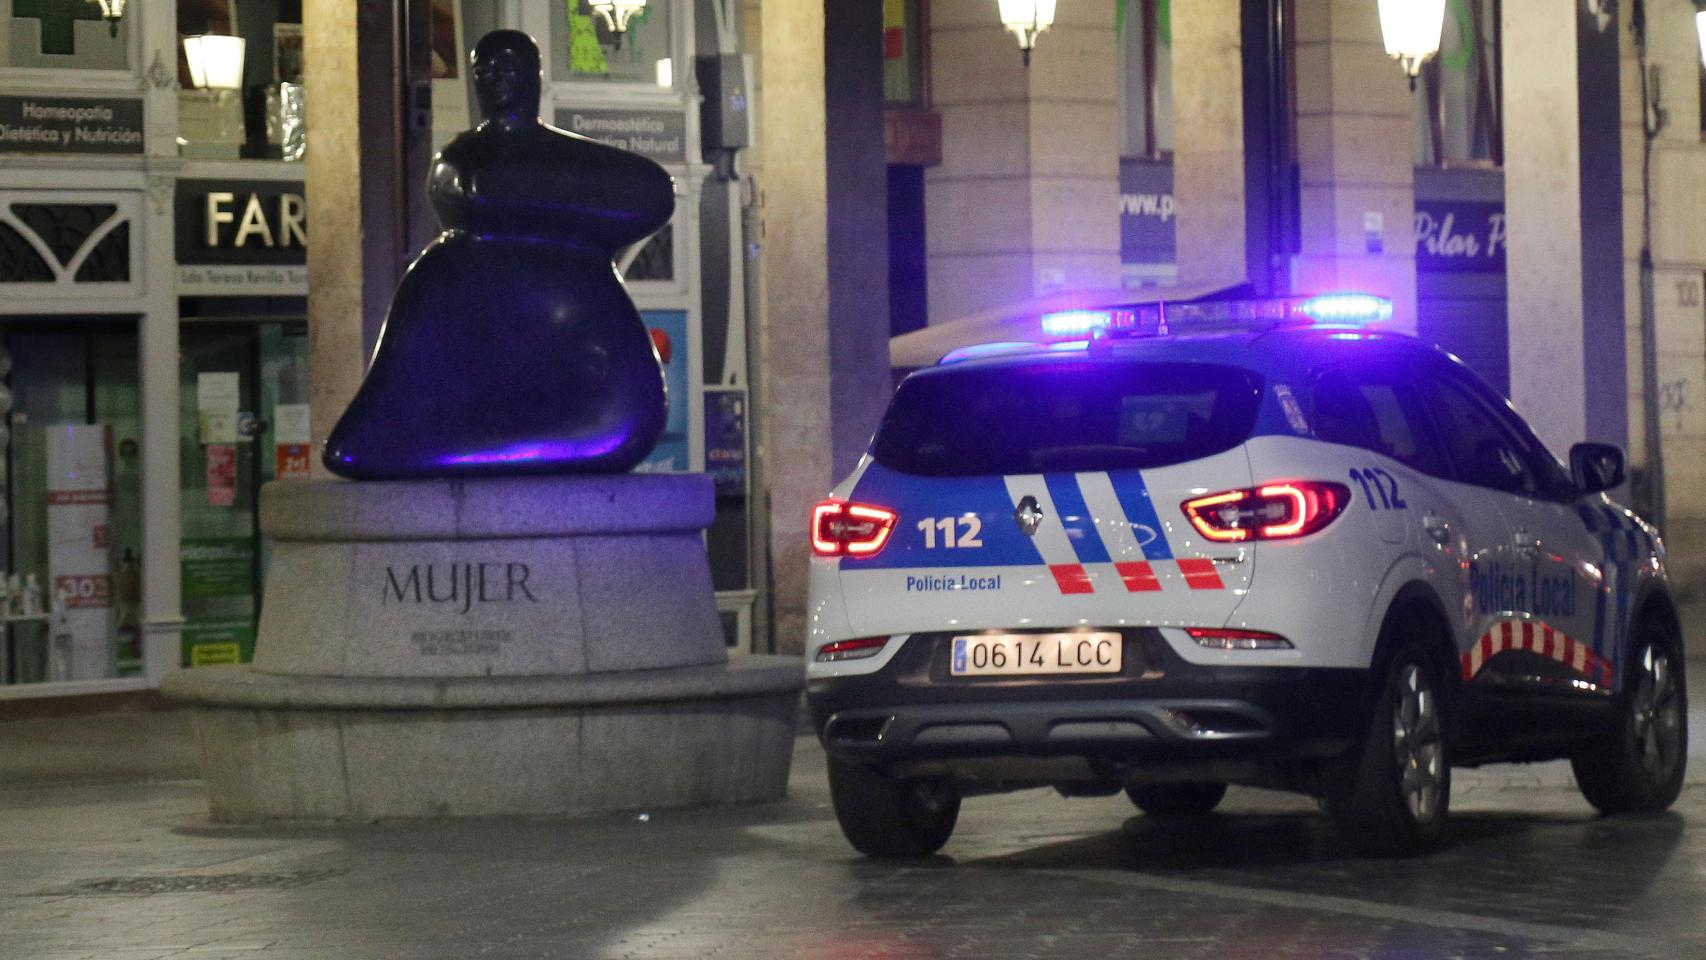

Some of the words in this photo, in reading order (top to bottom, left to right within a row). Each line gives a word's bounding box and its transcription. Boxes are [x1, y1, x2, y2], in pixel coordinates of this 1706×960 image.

[61, 131, 72, 146] y
[629, 136, 679, 152] Natural
[207, 191, 306, 247] FAR
[1414, 211, 1479, 257] Pilar
[1349, 467, 1407, 511] 112
[917, 512, 983, 549] 112
[382, 562, 538, 614] MUJER
[906, 575, 956, 592] Policía
[960, 574, 1001, 591] Local
[1531, 563, 1575, 615] Local
[973, 641, 1045, 669] 0614
[1057, 640, 1113, 667] LCC
